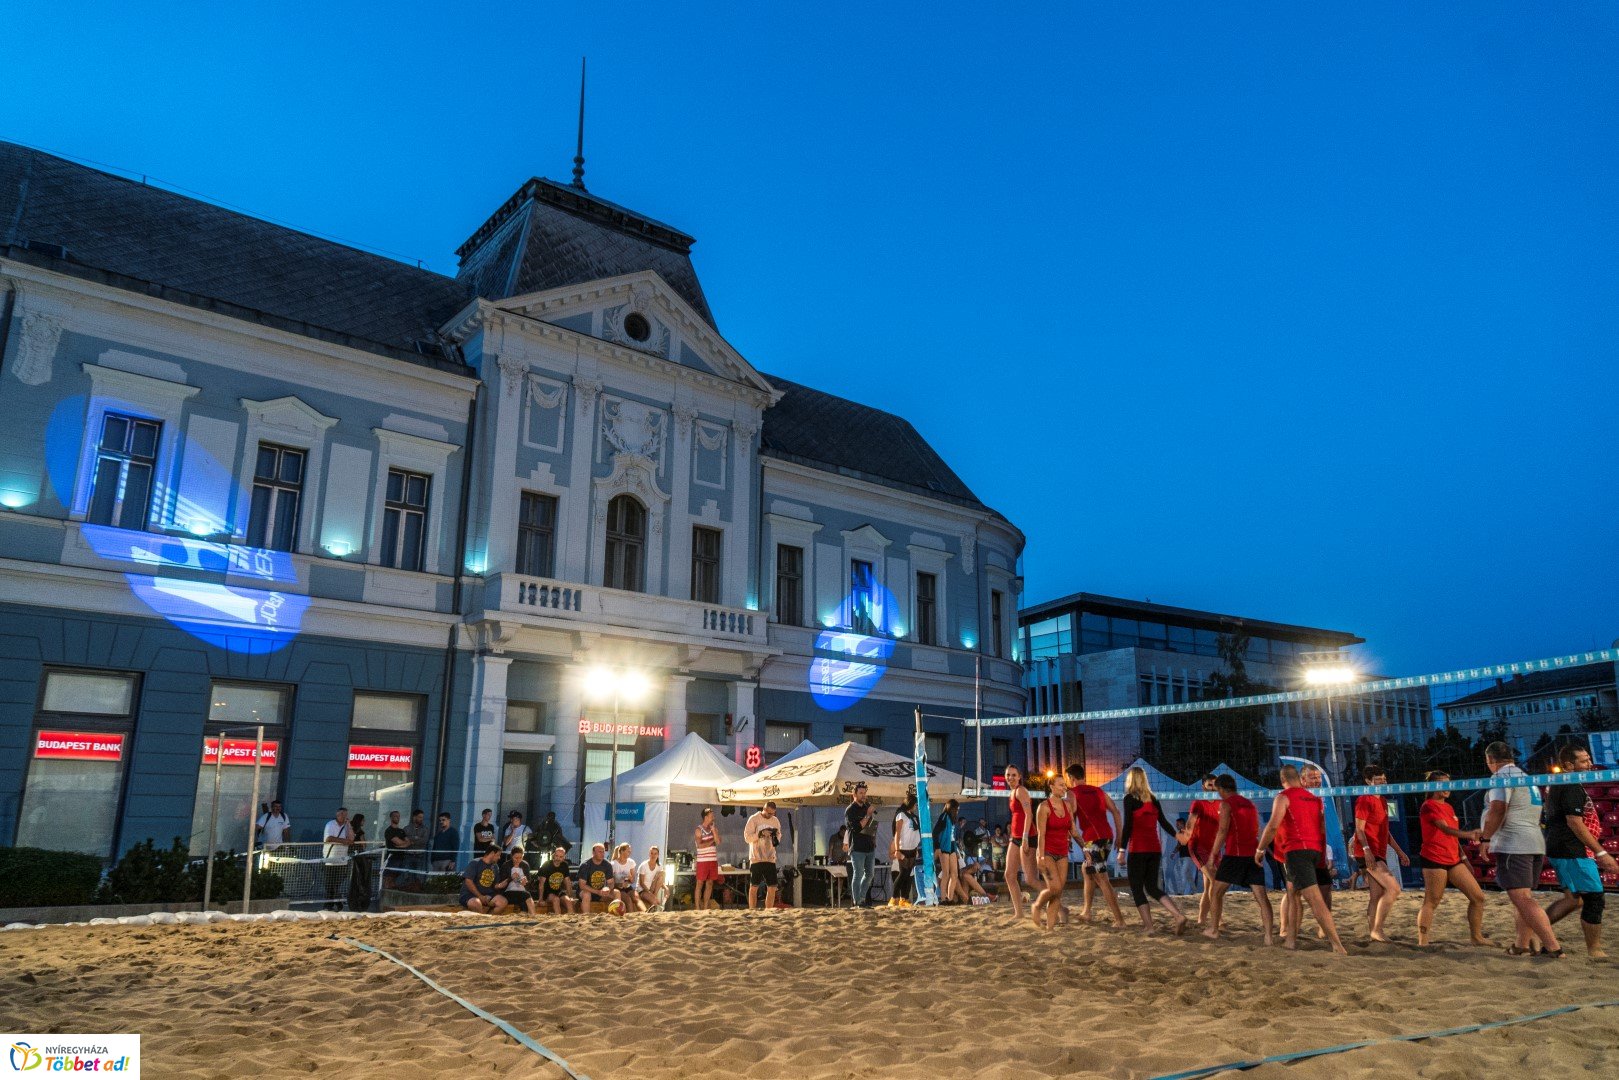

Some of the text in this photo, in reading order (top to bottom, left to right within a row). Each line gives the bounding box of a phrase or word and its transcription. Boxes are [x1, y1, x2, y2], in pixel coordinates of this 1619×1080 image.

[639, 726, 664, 737] BANK
[38, 740, 121, 752] BUDAPEST BANK
[205, 747, 251, 756] BUAPEST
[349, 753, 411, 763] BUDAPEST BANK
